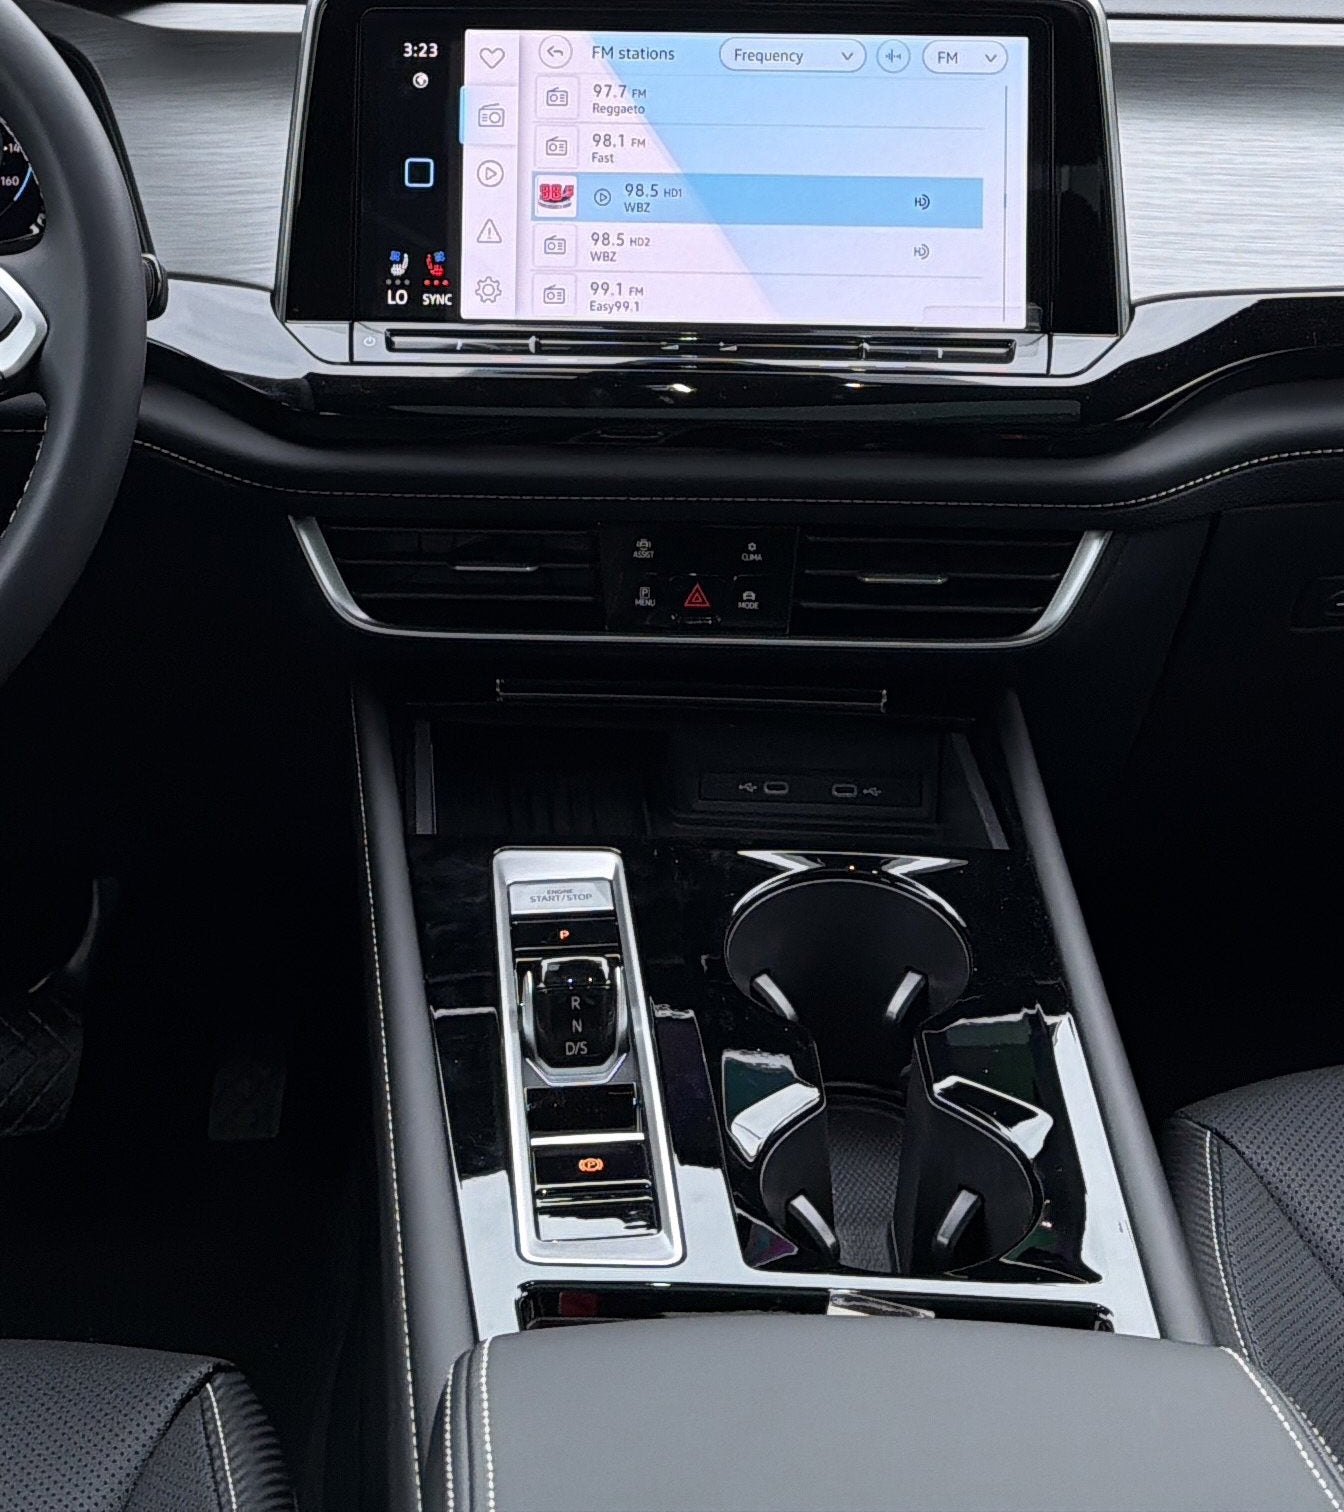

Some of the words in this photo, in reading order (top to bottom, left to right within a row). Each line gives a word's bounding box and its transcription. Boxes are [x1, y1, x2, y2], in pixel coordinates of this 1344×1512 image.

[403, 43, 438, 58] 3:23
[592, 46, 614, 60] FM
[618, 46, 675, 61] stations
[734, 48, 804, 65] Frequency
[937, 51, 958, 65] FM
[593, 84, 627, 99] 97.7
[632, 89, 647, 98] FM
[592, 103, 645, 116] Reggaeto
[592, 133, 625, 148] 98.1
[631, 138, 646, 148] FM
[592, 152, 615, 163] Fast
[0, 175, 20, 187] 160
[624, 183, 659, 198] 98.5
[664, 188, 682, 198] HD1
[624, 202, 651, 213] WBZ
[590, 232, 625, 247] 98.5
[630, 237, 650, 247] HD2
[590, 251, 617, 262] WBZ
[590, 282, 622, 296] 99.1
[629, 287, 644, 296] FM
[387, 289, 408, 305] LO
[422, 293, 453, 306] SYNC
[589, 300, 640, 314] Easy99.1
[741, 553, 763, 561] CLIMA
[634, 598, 656, 607] MENU
[737, 601, 760, 610] MODE
[529, 892, 593, 904] START/STOP
[559, 929, 570, 940] P
[570, 996, 581, 1011] R
[571, 1018, 583, 1033] N
[565, 1040, 588, 1056] D/S
